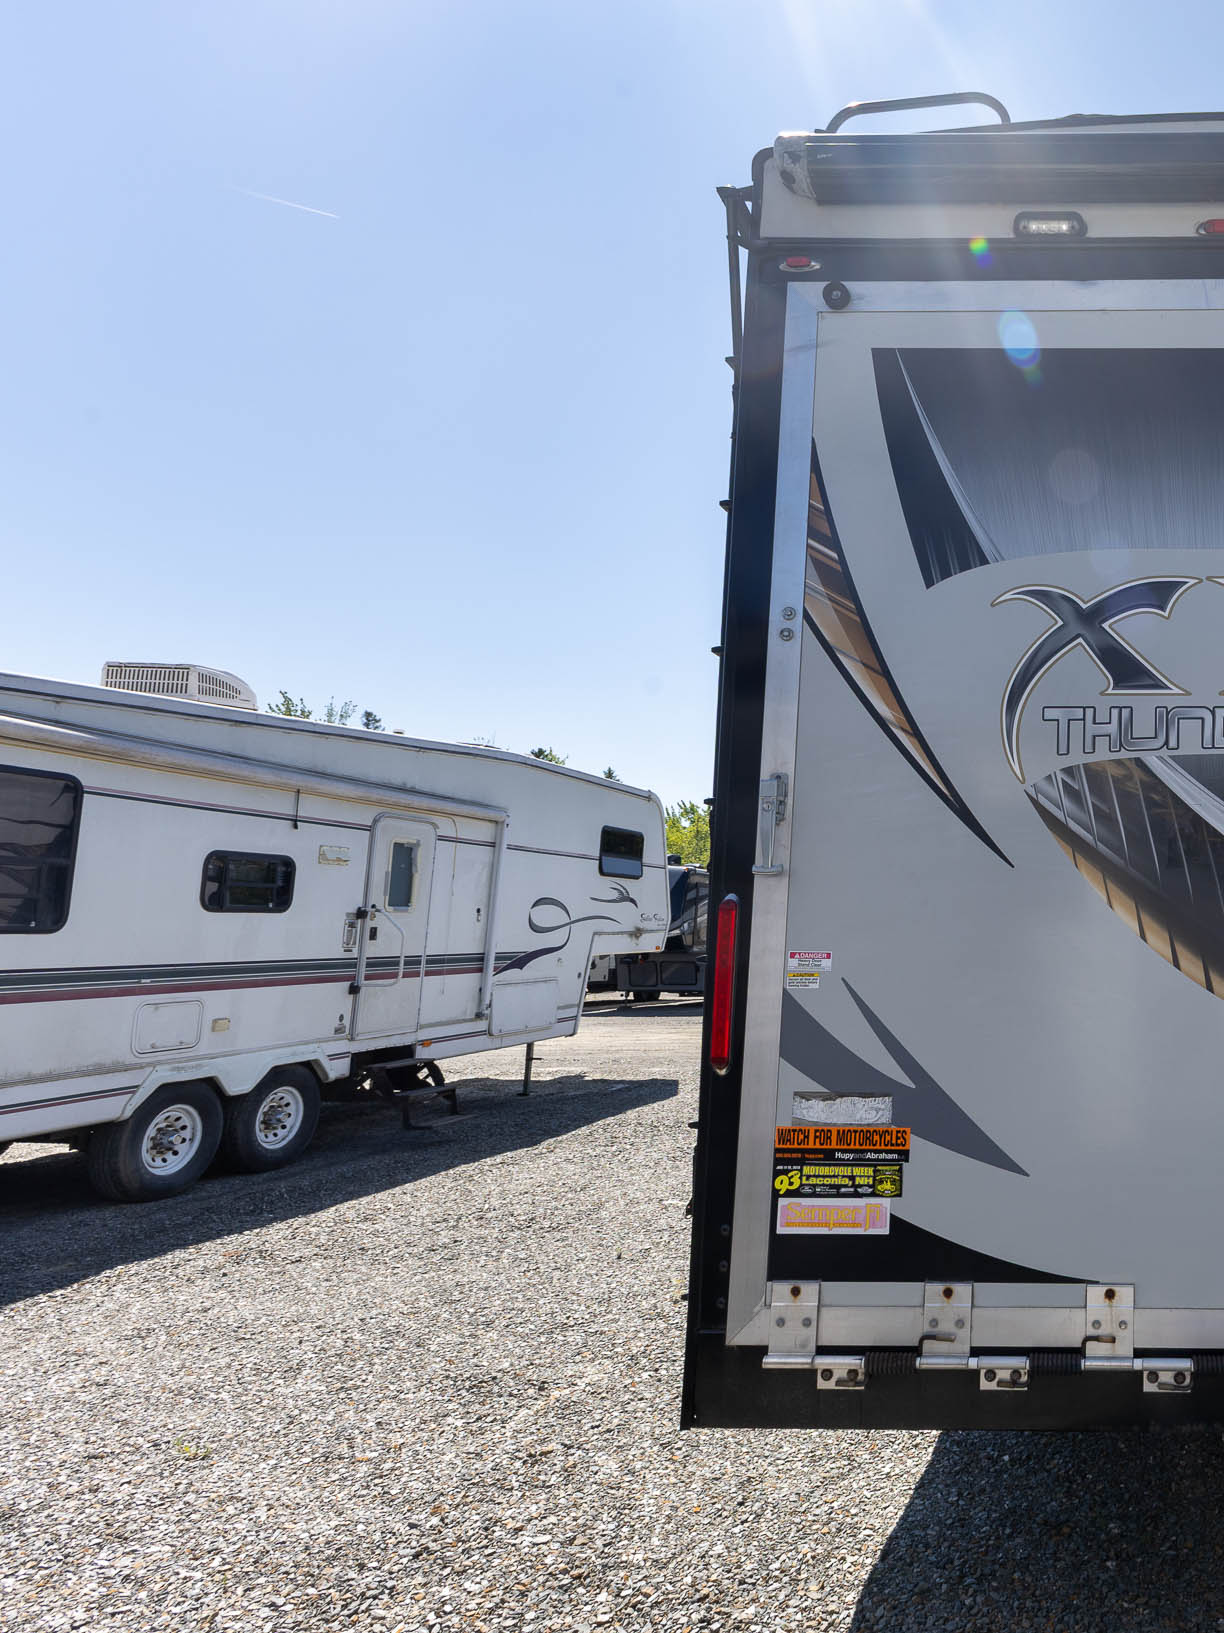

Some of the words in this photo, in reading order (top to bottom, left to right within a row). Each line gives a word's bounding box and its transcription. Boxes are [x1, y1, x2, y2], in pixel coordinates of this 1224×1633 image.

[777, 1128, 810, 1146] WATCH
[813, 1128, 832, 1146] FOR
[836, 1129, 907, 1147] MOTORCYCLES
[802, 1165, 852, 1176] MOTORCYCLE
[853, 1166, 874, 1176] WEEK
[774, 1170, 801, 1195] 93
[802, 1177, 852, 1186] Laconia,
[855, 1177, 873, 1185] NH
[787, 1202, 863, 1231] Semper
